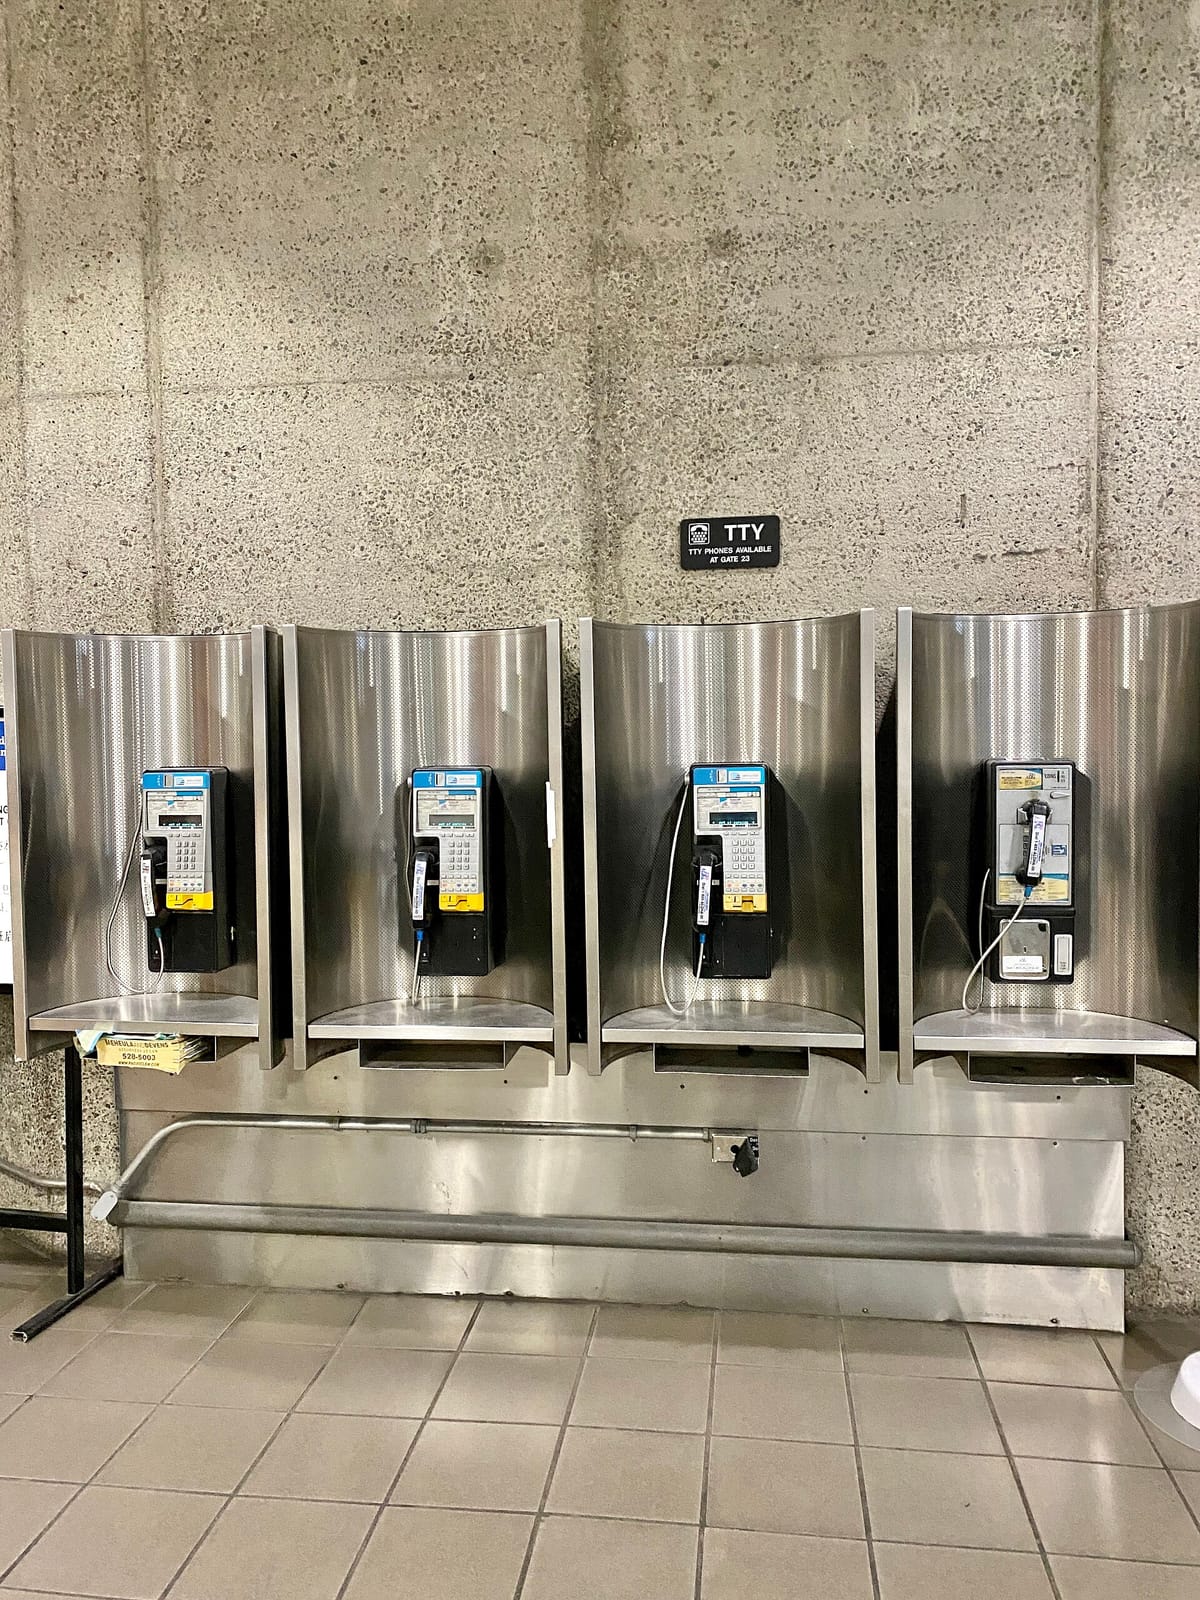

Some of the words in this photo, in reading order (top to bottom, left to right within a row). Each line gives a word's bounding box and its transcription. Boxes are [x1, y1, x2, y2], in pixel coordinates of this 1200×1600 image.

[724, 523, 765, 541] TTY
[688, 548, 702, 556] TTY
[704, 546, 733, 555] PHONES
[735, 545, 772, 553] AVAILABLE
[709, 556, 719, 564] AT
[720, 555, 739, 563] GATE
